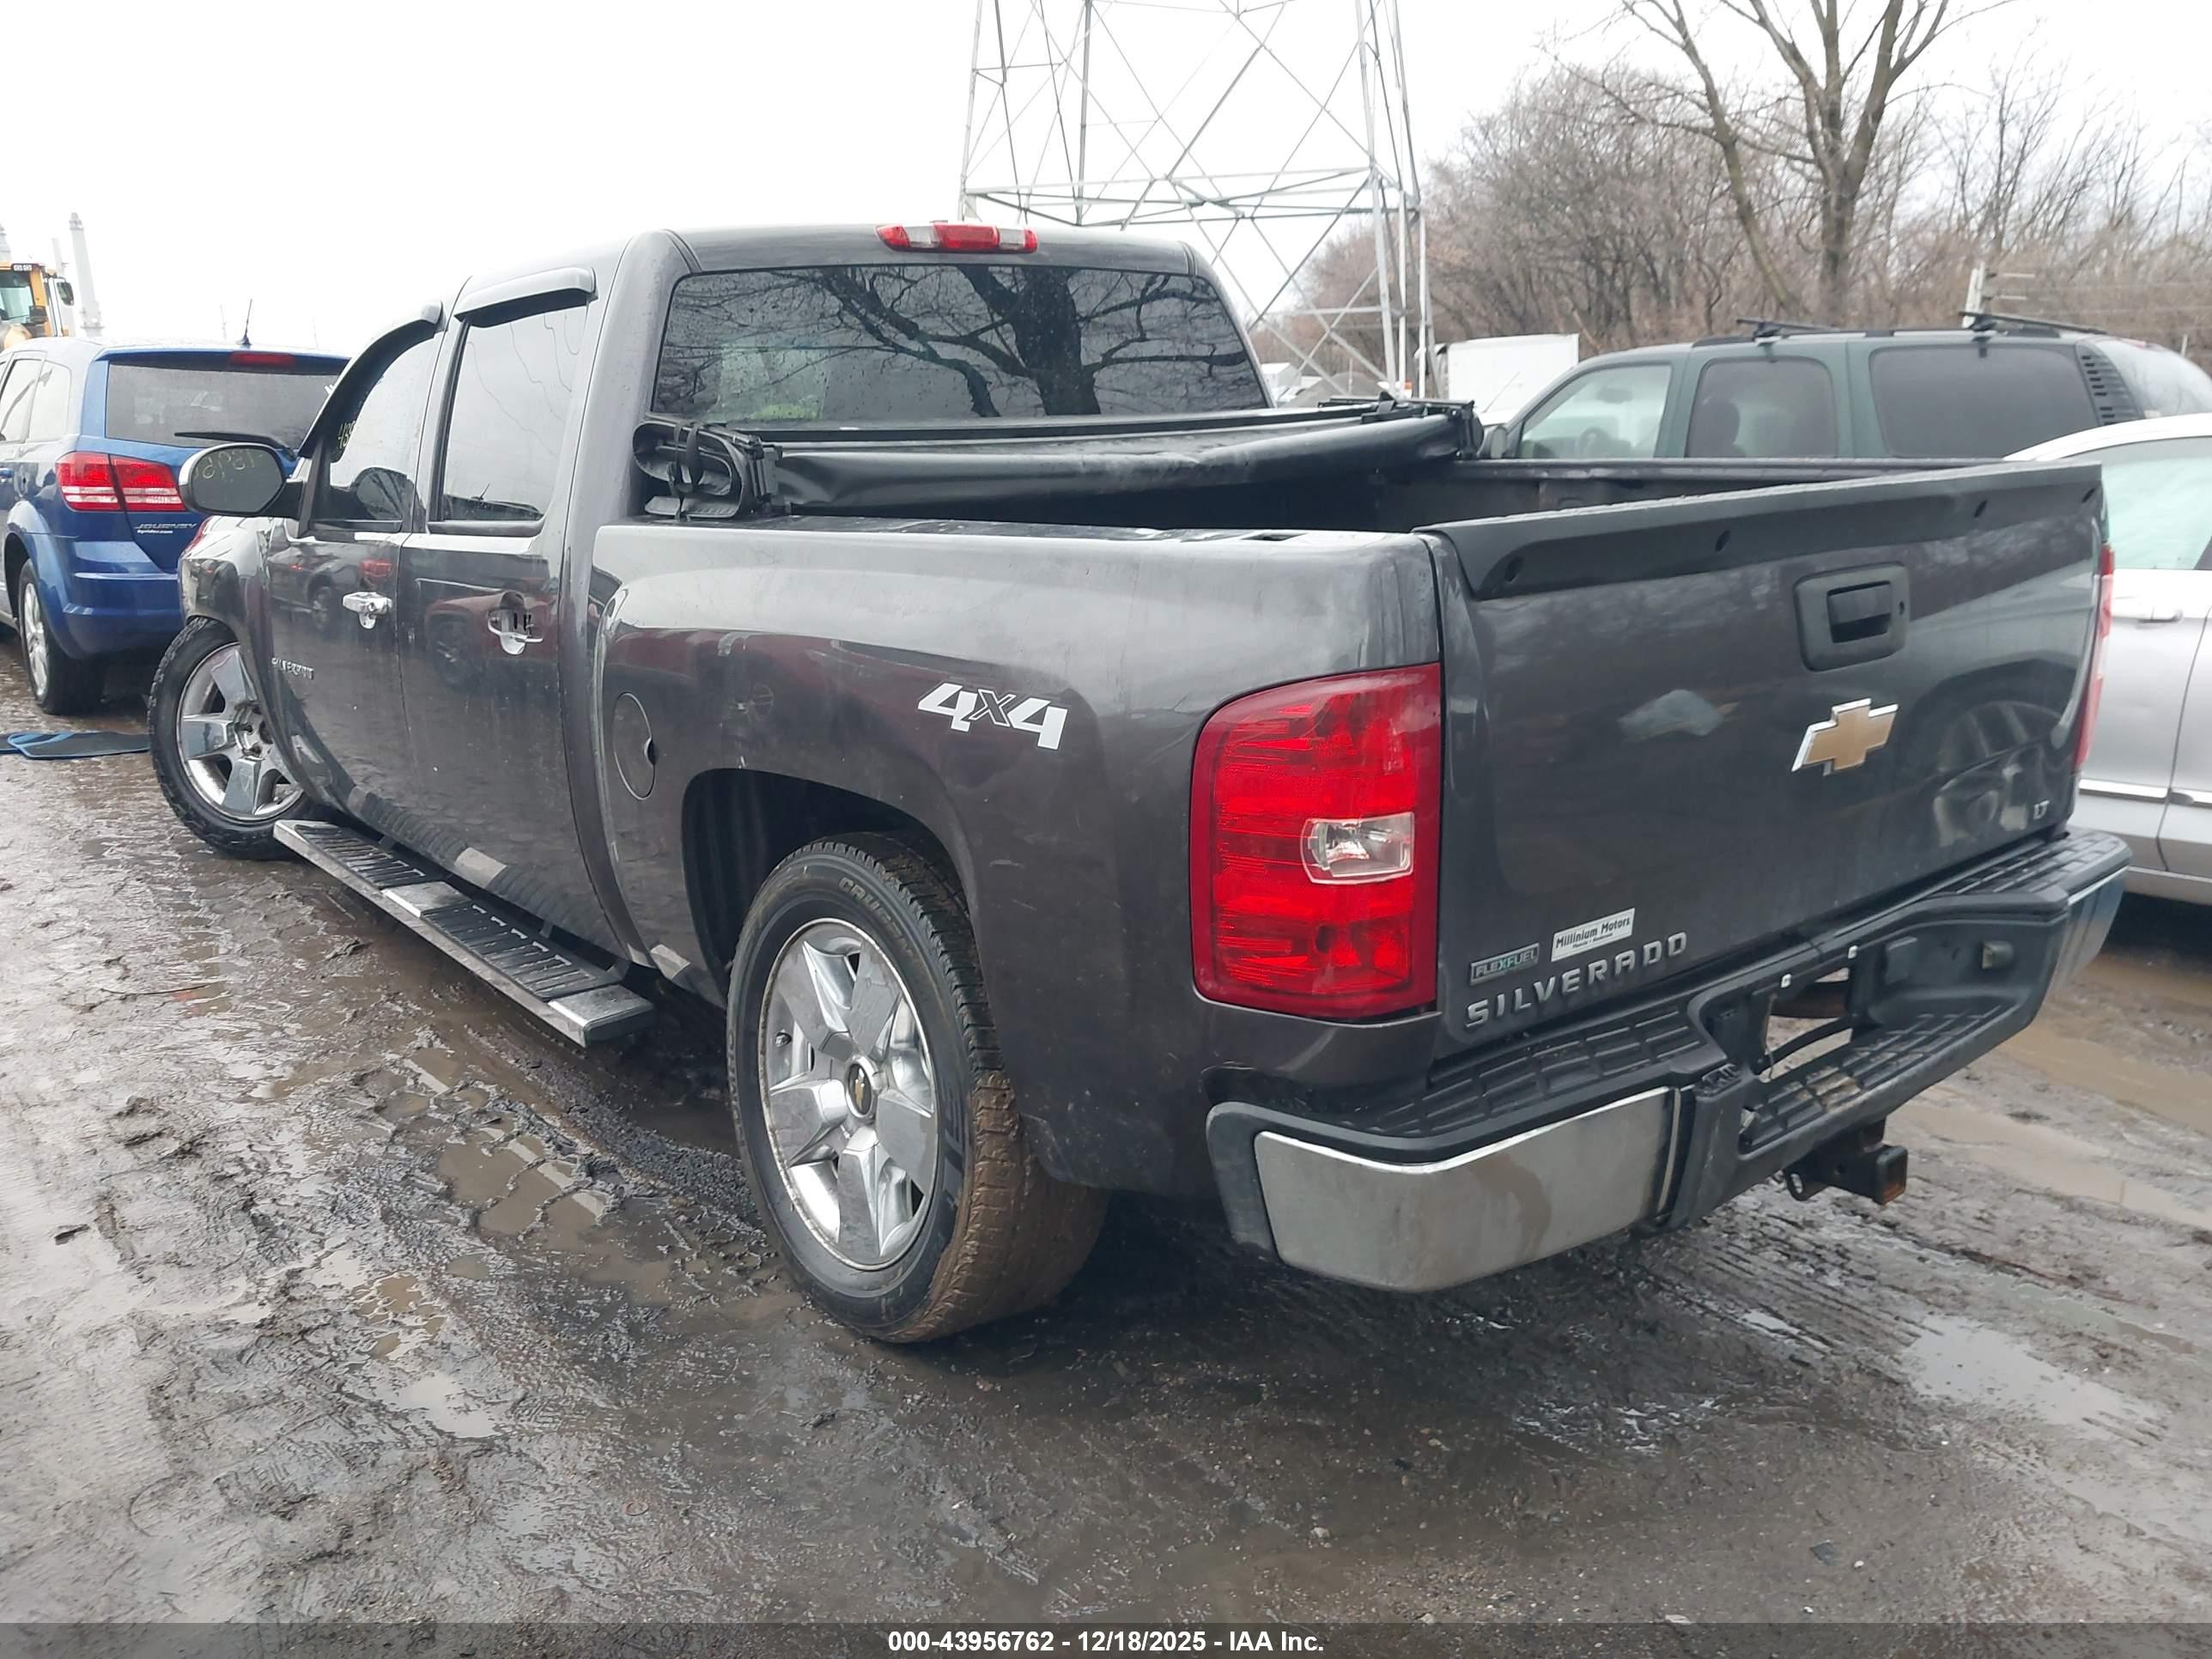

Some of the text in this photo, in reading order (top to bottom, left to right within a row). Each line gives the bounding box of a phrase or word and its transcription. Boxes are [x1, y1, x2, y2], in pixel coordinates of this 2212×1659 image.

[1601, 917, 1631, 935] Motors
[1475, 948, 1536, 977] FLEXFUEL
[1466, 932, 1687, 1028] SILVERADO
